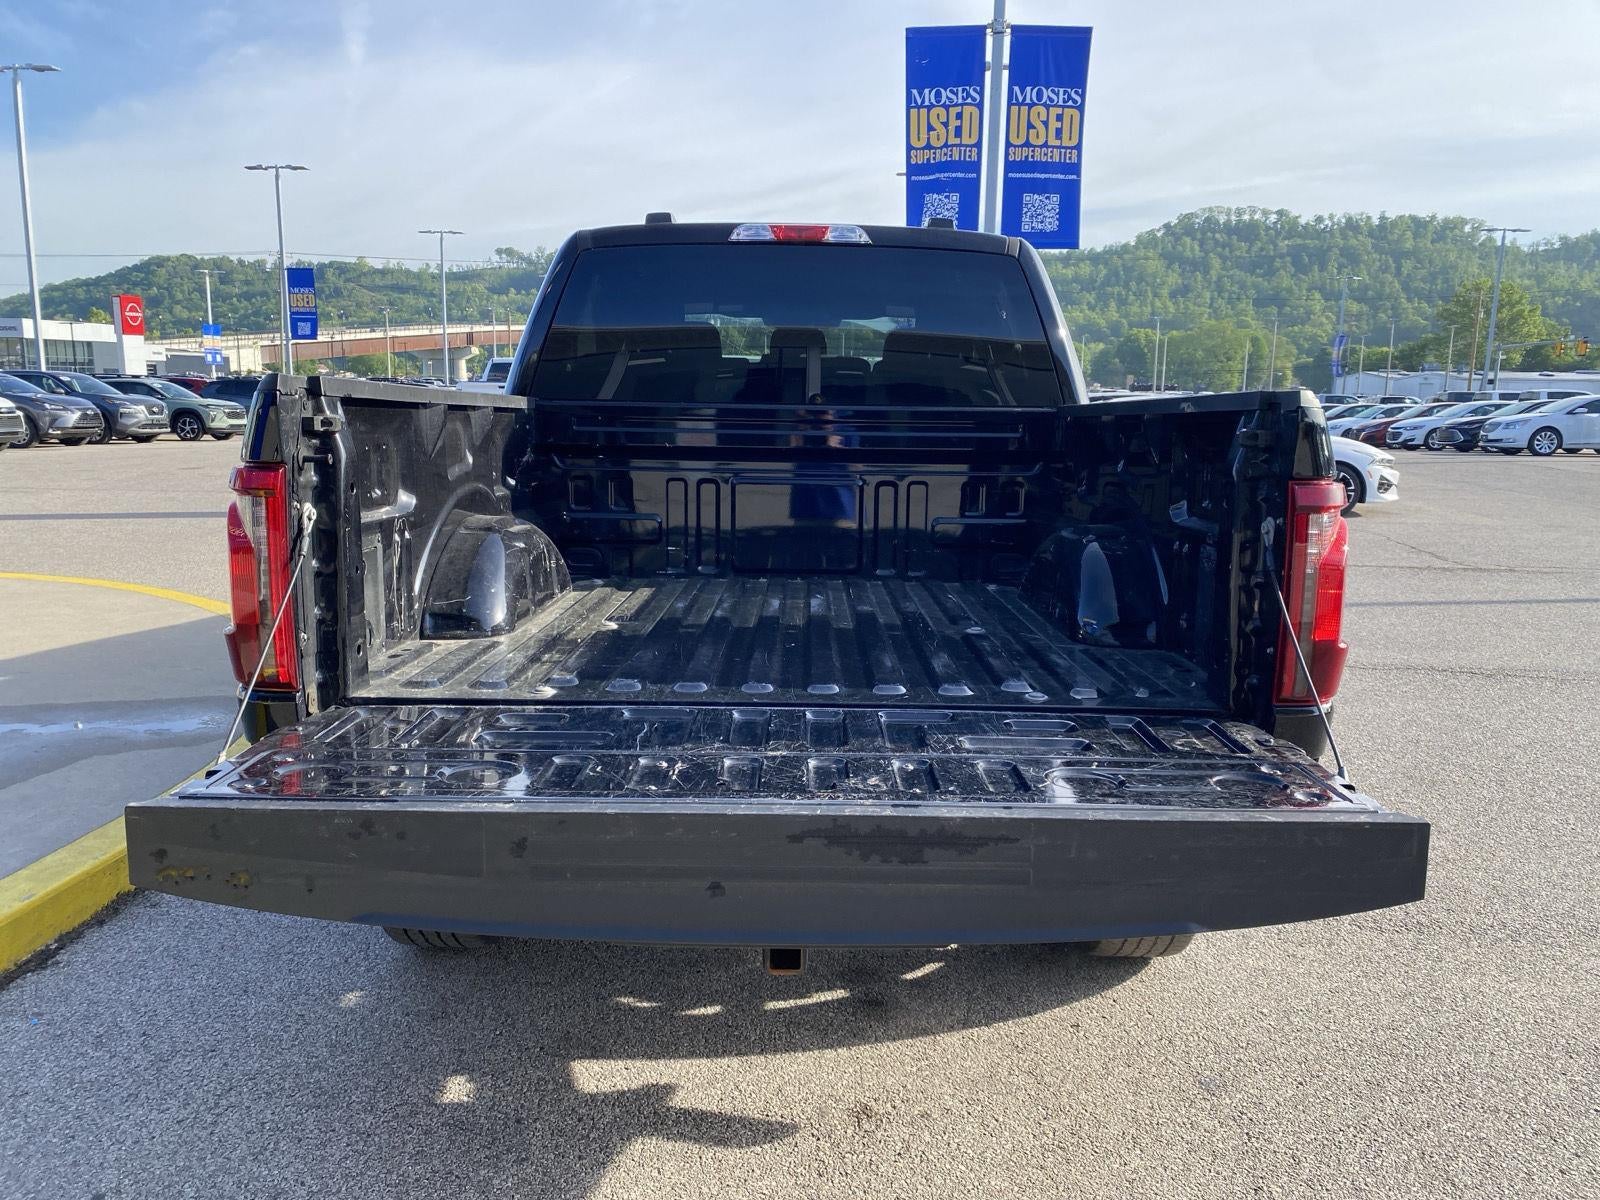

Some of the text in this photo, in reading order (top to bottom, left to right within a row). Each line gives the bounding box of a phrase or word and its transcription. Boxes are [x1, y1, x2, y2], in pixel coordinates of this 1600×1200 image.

[910, 86, 980, 106] MOSES
[1012, 86, 1082, 106] MOSES
[910, 106, 980, 148] USED
[1009, 105, 1080, 146] USED
[910, 147, 978, 164] SUPERCENTER
[1008, 147, 1078, 163] SUPERCENTER
[290, 294, 316, 307] USED
